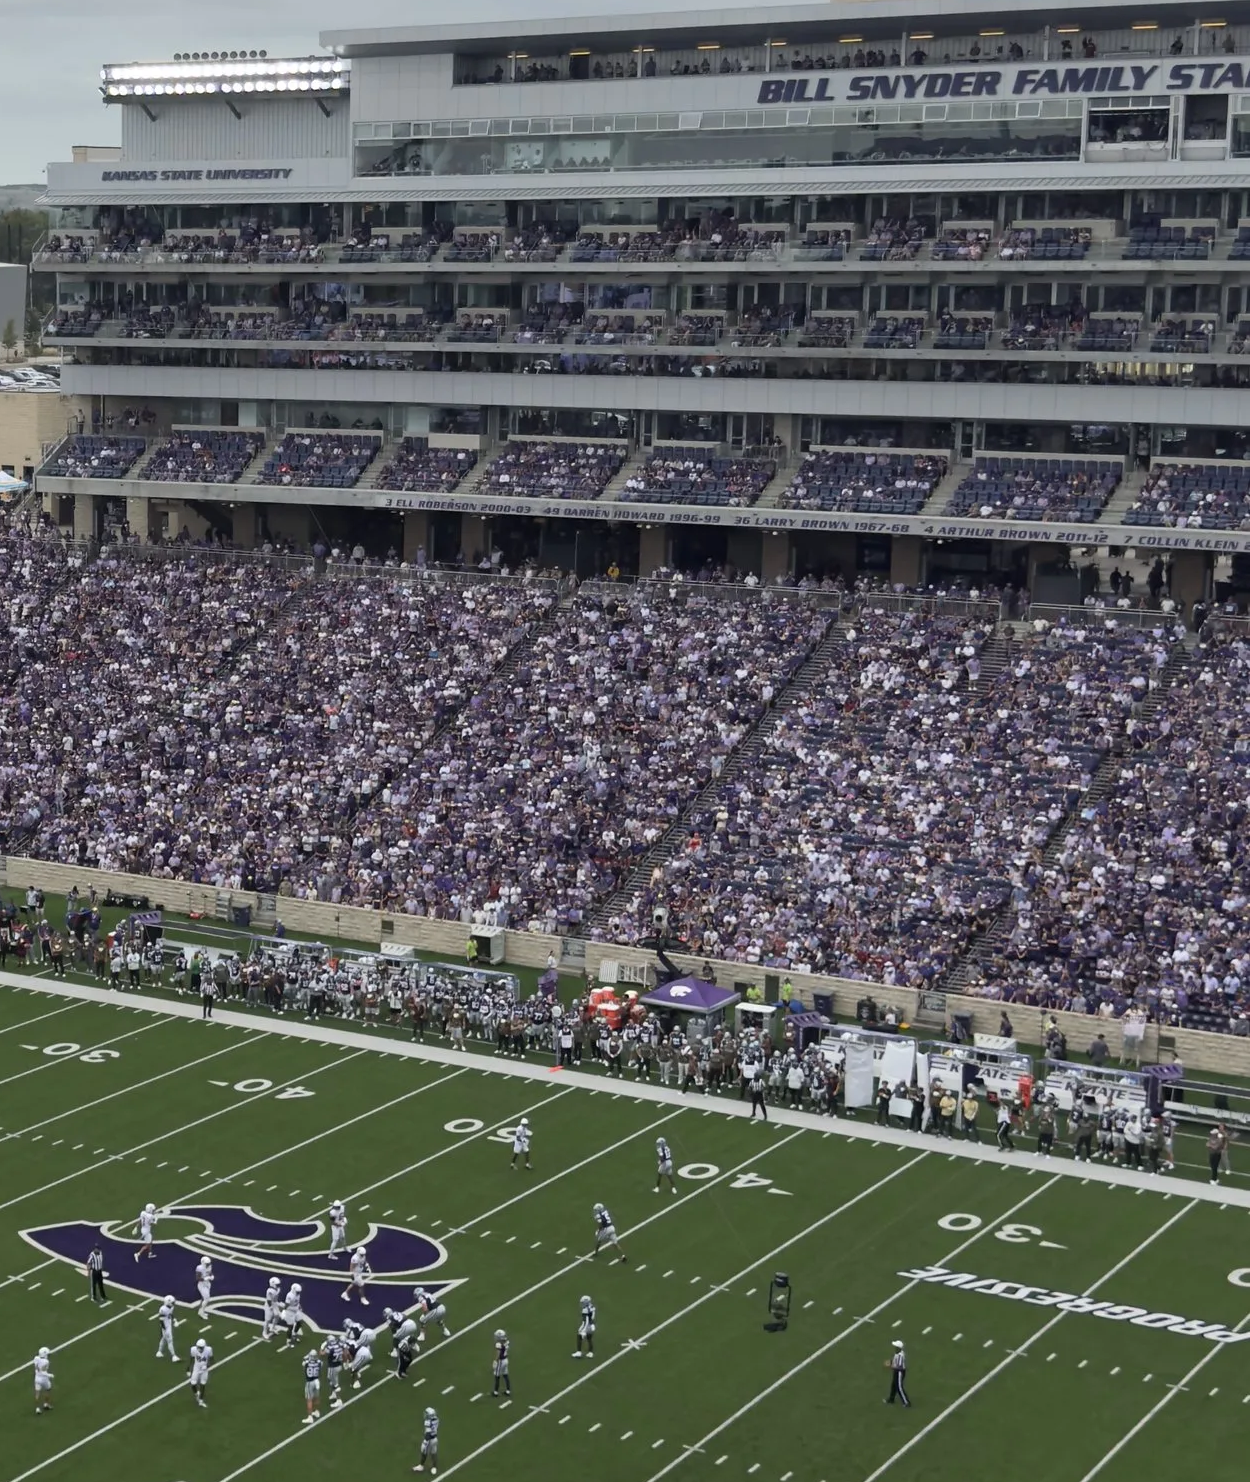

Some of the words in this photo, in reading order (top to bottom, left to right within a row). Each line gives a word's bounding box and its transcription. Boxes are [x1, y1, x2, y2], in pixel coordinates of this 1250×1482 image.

[757, 77, 835, 104] BILL
[846, 70, 1002, 101] SNYDER
[1012, 64, 1159, 94] FAMILY
[101, 171, 158, 182] KANSAS
[160, 170, 204, 181] STATE
[205, 168, 294, 180] UNIVERSITY
[385, 498, 393, 507] 3
[396, 499, 415, 508] ELL
[418, 500, 478, 511] ROBERSON
[480, 504, 531, 514] 2000-03
[544, 507, 560, 516] 49
[564, 508, 610, 519] DARREN
[613, 510, 665, 521] HOWARD
[668, 513, 721, 524] 1996-99
[734, 516, 751, 526] 36
[755, 517, 797, 528] LARRY
[801, 519, 849, 530] BROWN
[854, 522, 910, 533] 1967-68
[924, 525, 934, 534] 4
[937, 525, 994, 538] ARTHUR
[999, 529, 1052, 540] BROWN
[1056, 532, 1109, 543] 2011-12
[1124, 535, 1132, 544] 7
[1138, 536, 1189, 547] COLLIN
[1194, 539, 1239, 550] KLEIN
[42, 1041, 121, 1064] 30
[233, 1077, 316, 1101] 40
[676, 1161, 772, 1192] 40
[937, 1212, 1043, 1245] 30
[897, 1264, 1250, 1343] PROGRESSIVE
